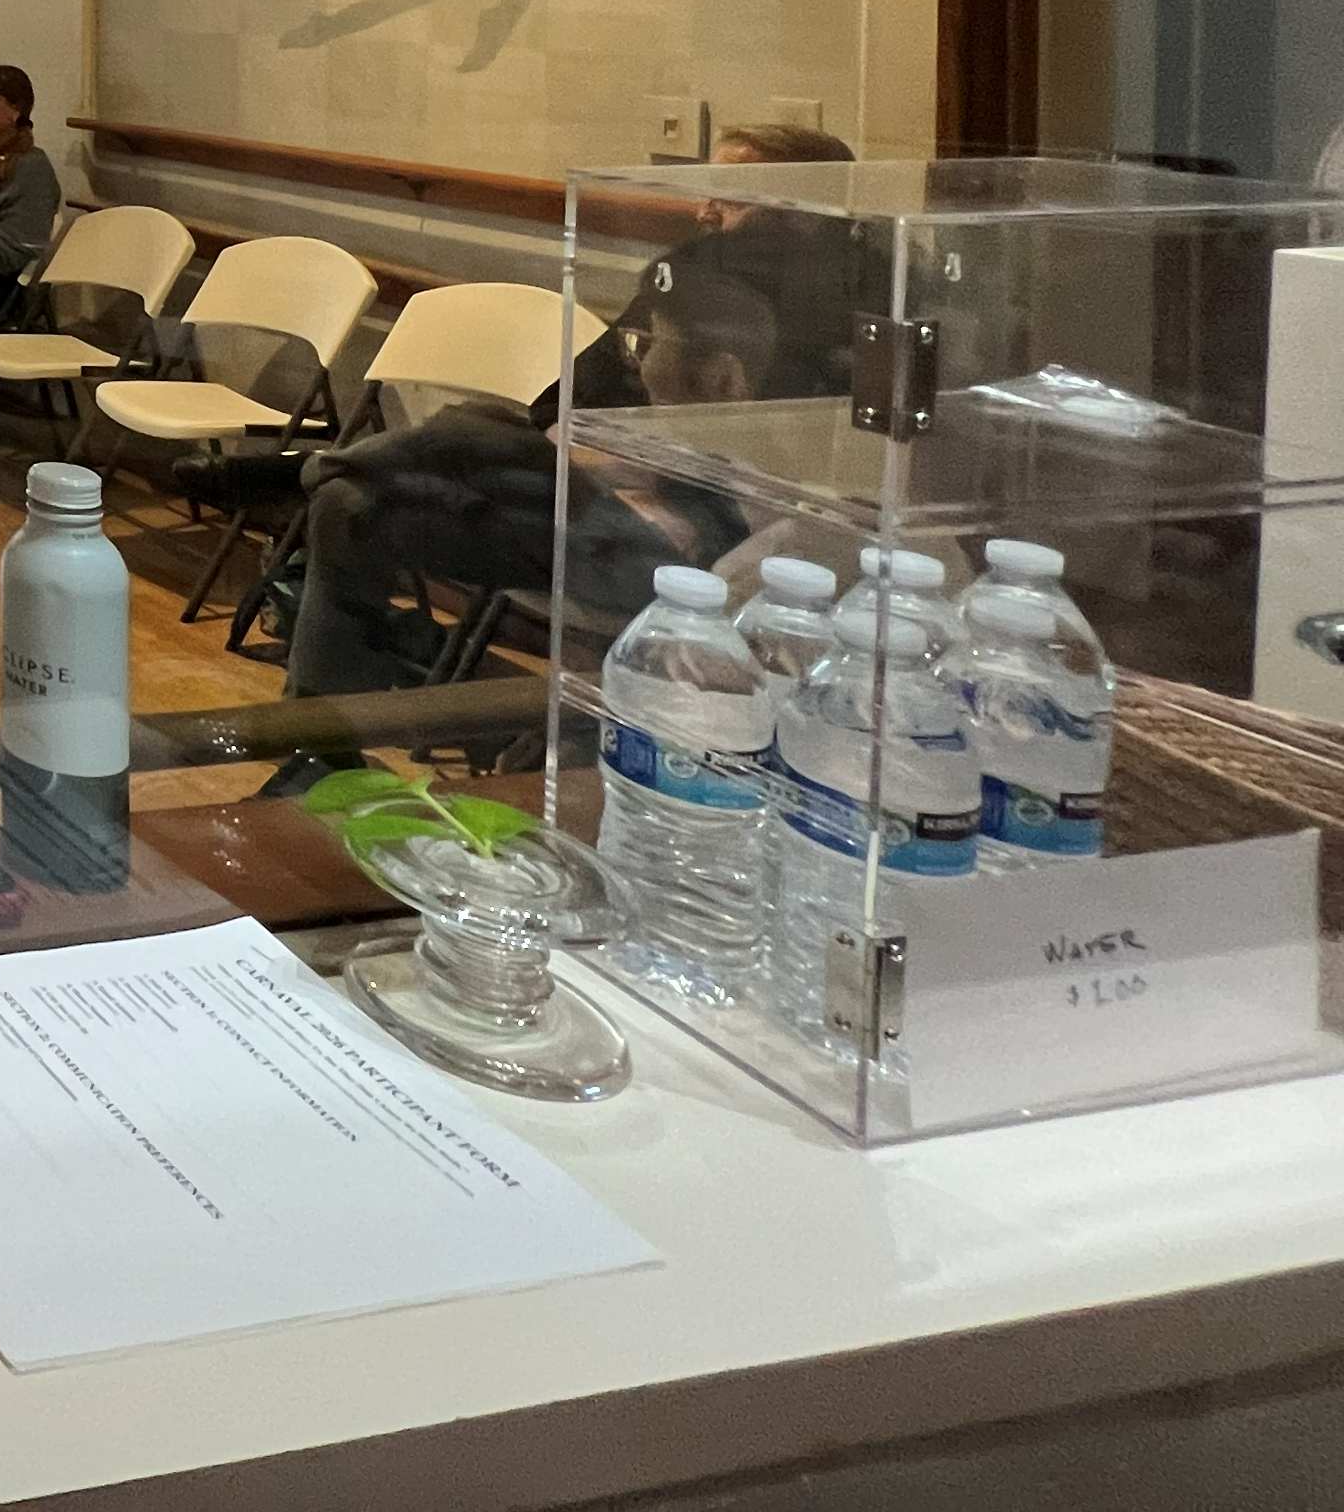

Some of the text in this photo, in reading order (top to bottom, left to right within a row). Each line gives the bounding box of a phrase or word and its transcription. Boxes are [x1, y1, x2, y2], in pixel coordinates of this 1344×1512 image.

[48, 1042, 137, 1135] COMMUNICATION
[136, 1135, 223, 1220] PREFERENCES
[235, 959, 314, 1019] CARNAVAL
[344, 1049, 461, 1140] PARTICIPANT
[458, 1140, 521, 1190] FORM
